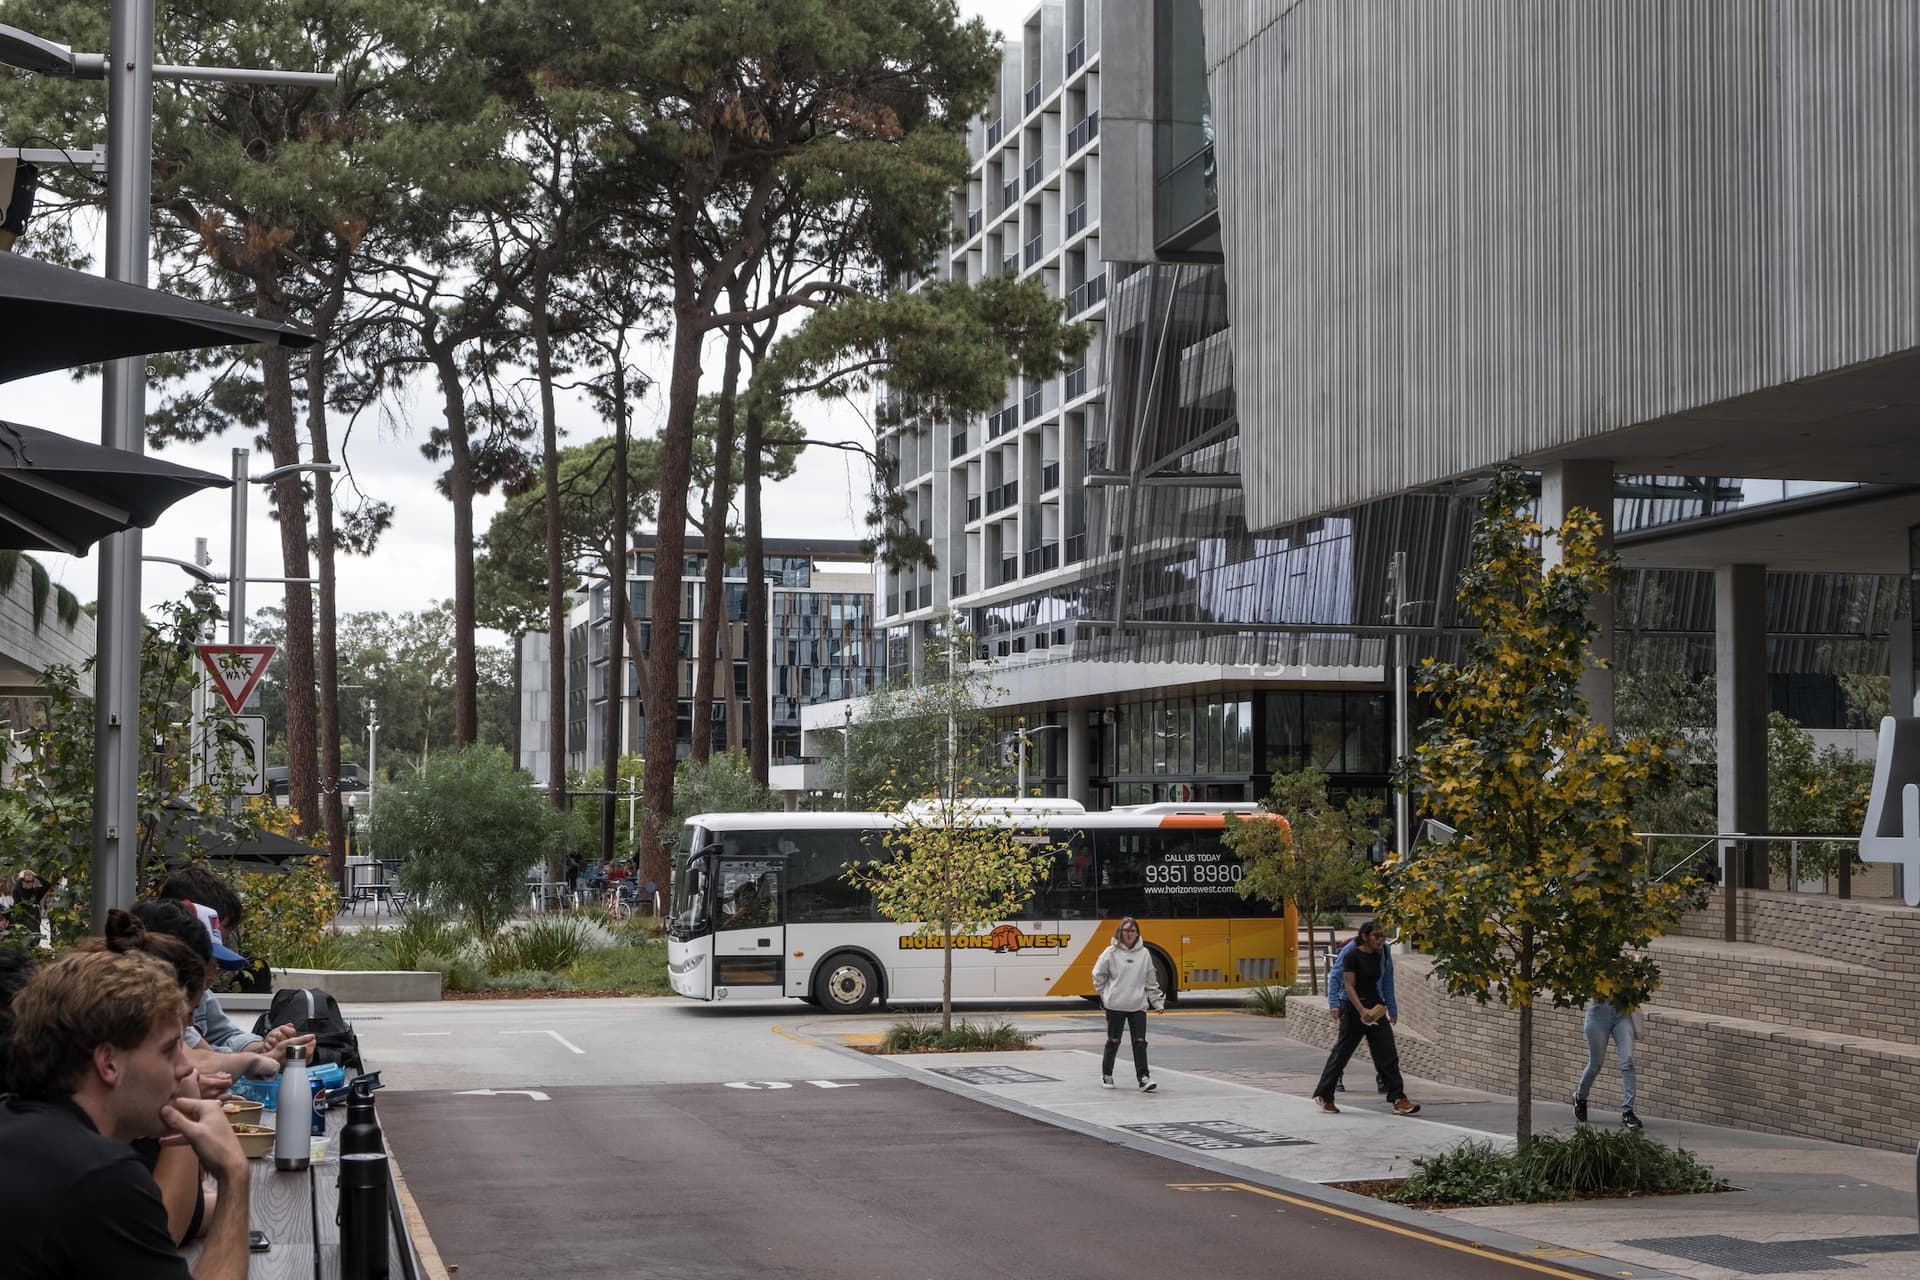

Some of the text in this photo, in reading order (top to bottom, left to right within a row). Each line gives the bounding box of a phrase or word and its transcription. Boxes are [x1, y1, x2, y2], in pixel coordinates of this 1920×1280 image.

[226, 671, 248, 680] WAY
[1165, 853, 1221, 862] CALL US TODAY
[1145, 864, 1242, 883] 9351 8980
[1017, 934, 1071, 949] WEST
